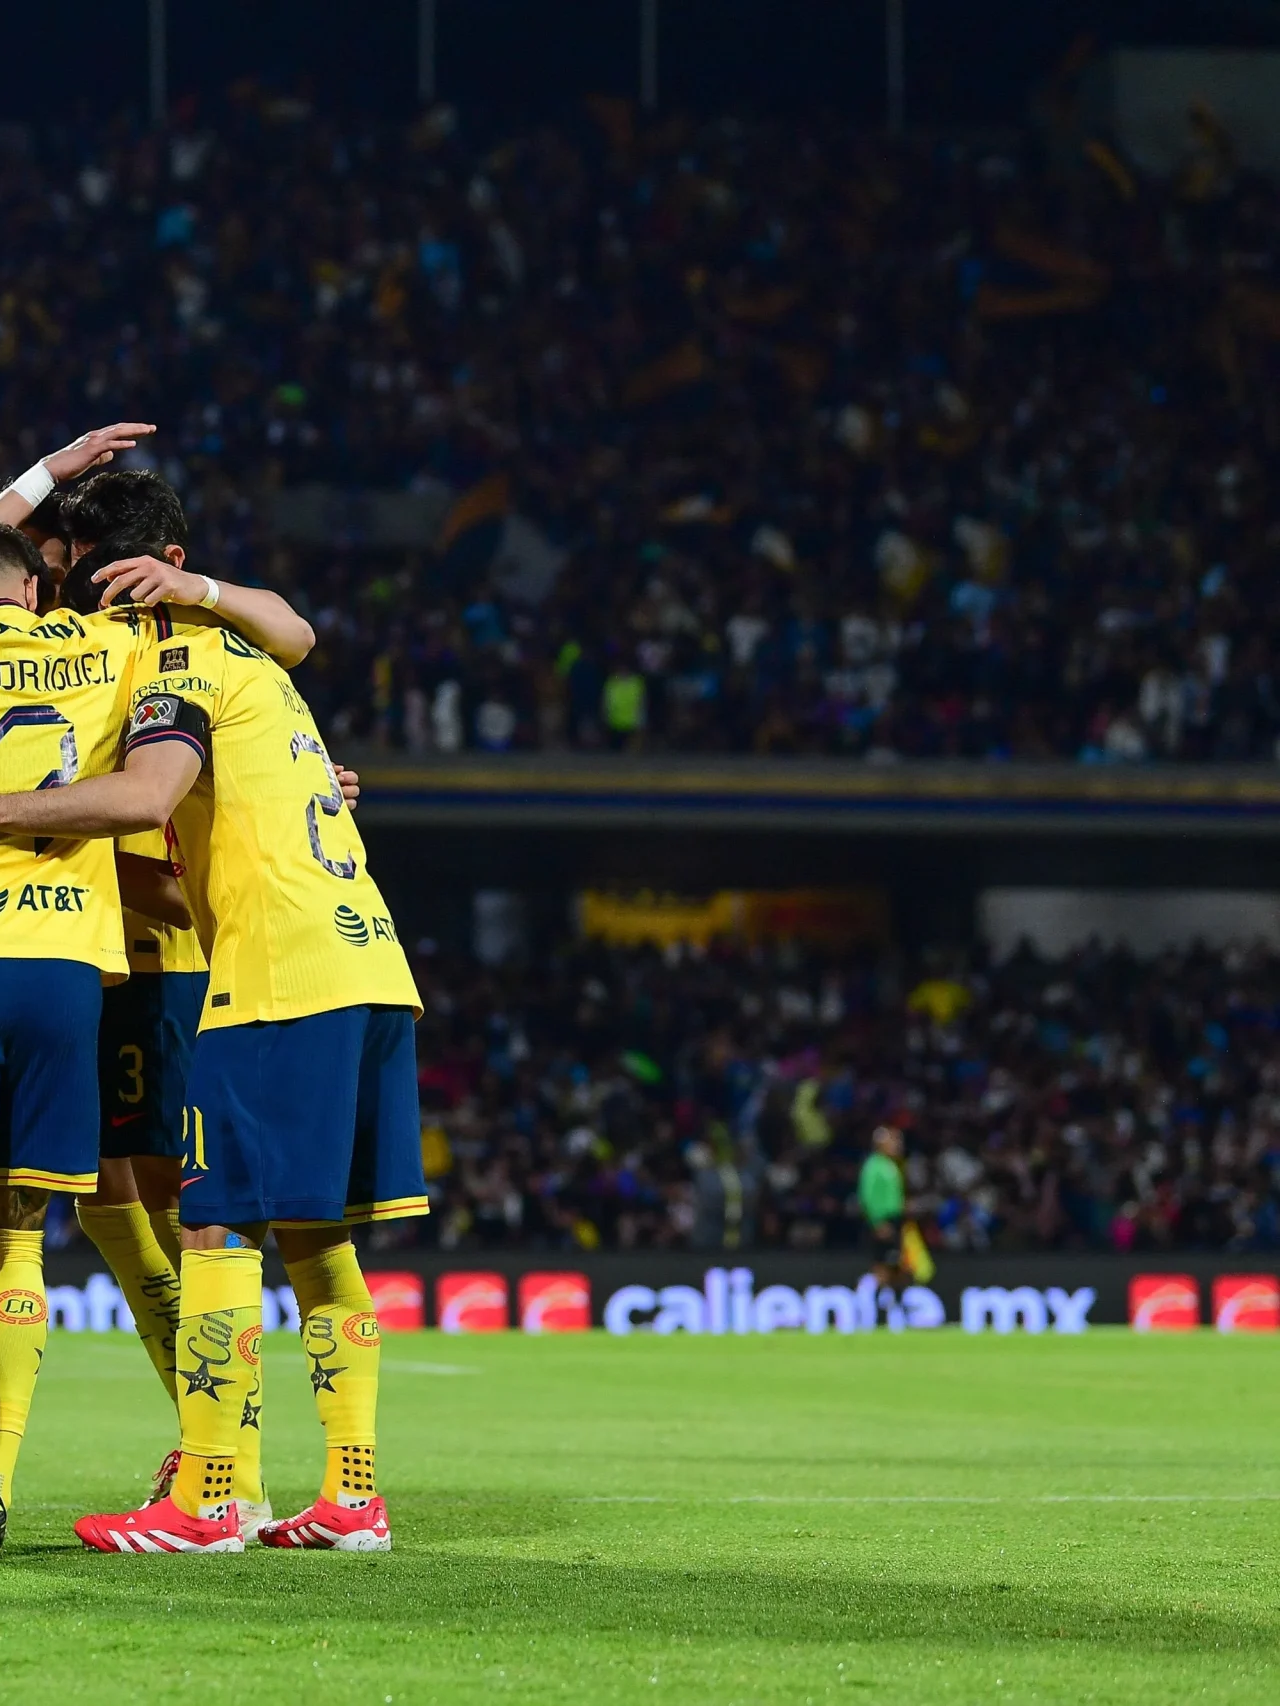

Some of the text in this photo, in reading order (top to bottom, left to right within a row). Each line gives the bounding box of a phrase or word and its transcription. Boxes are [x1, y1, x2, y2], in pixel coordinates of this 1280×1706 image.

[16, 883, 90, 912] AT&T
[371, 915, 399, 943] AT
[118, 1044, 144, 1104] 3
